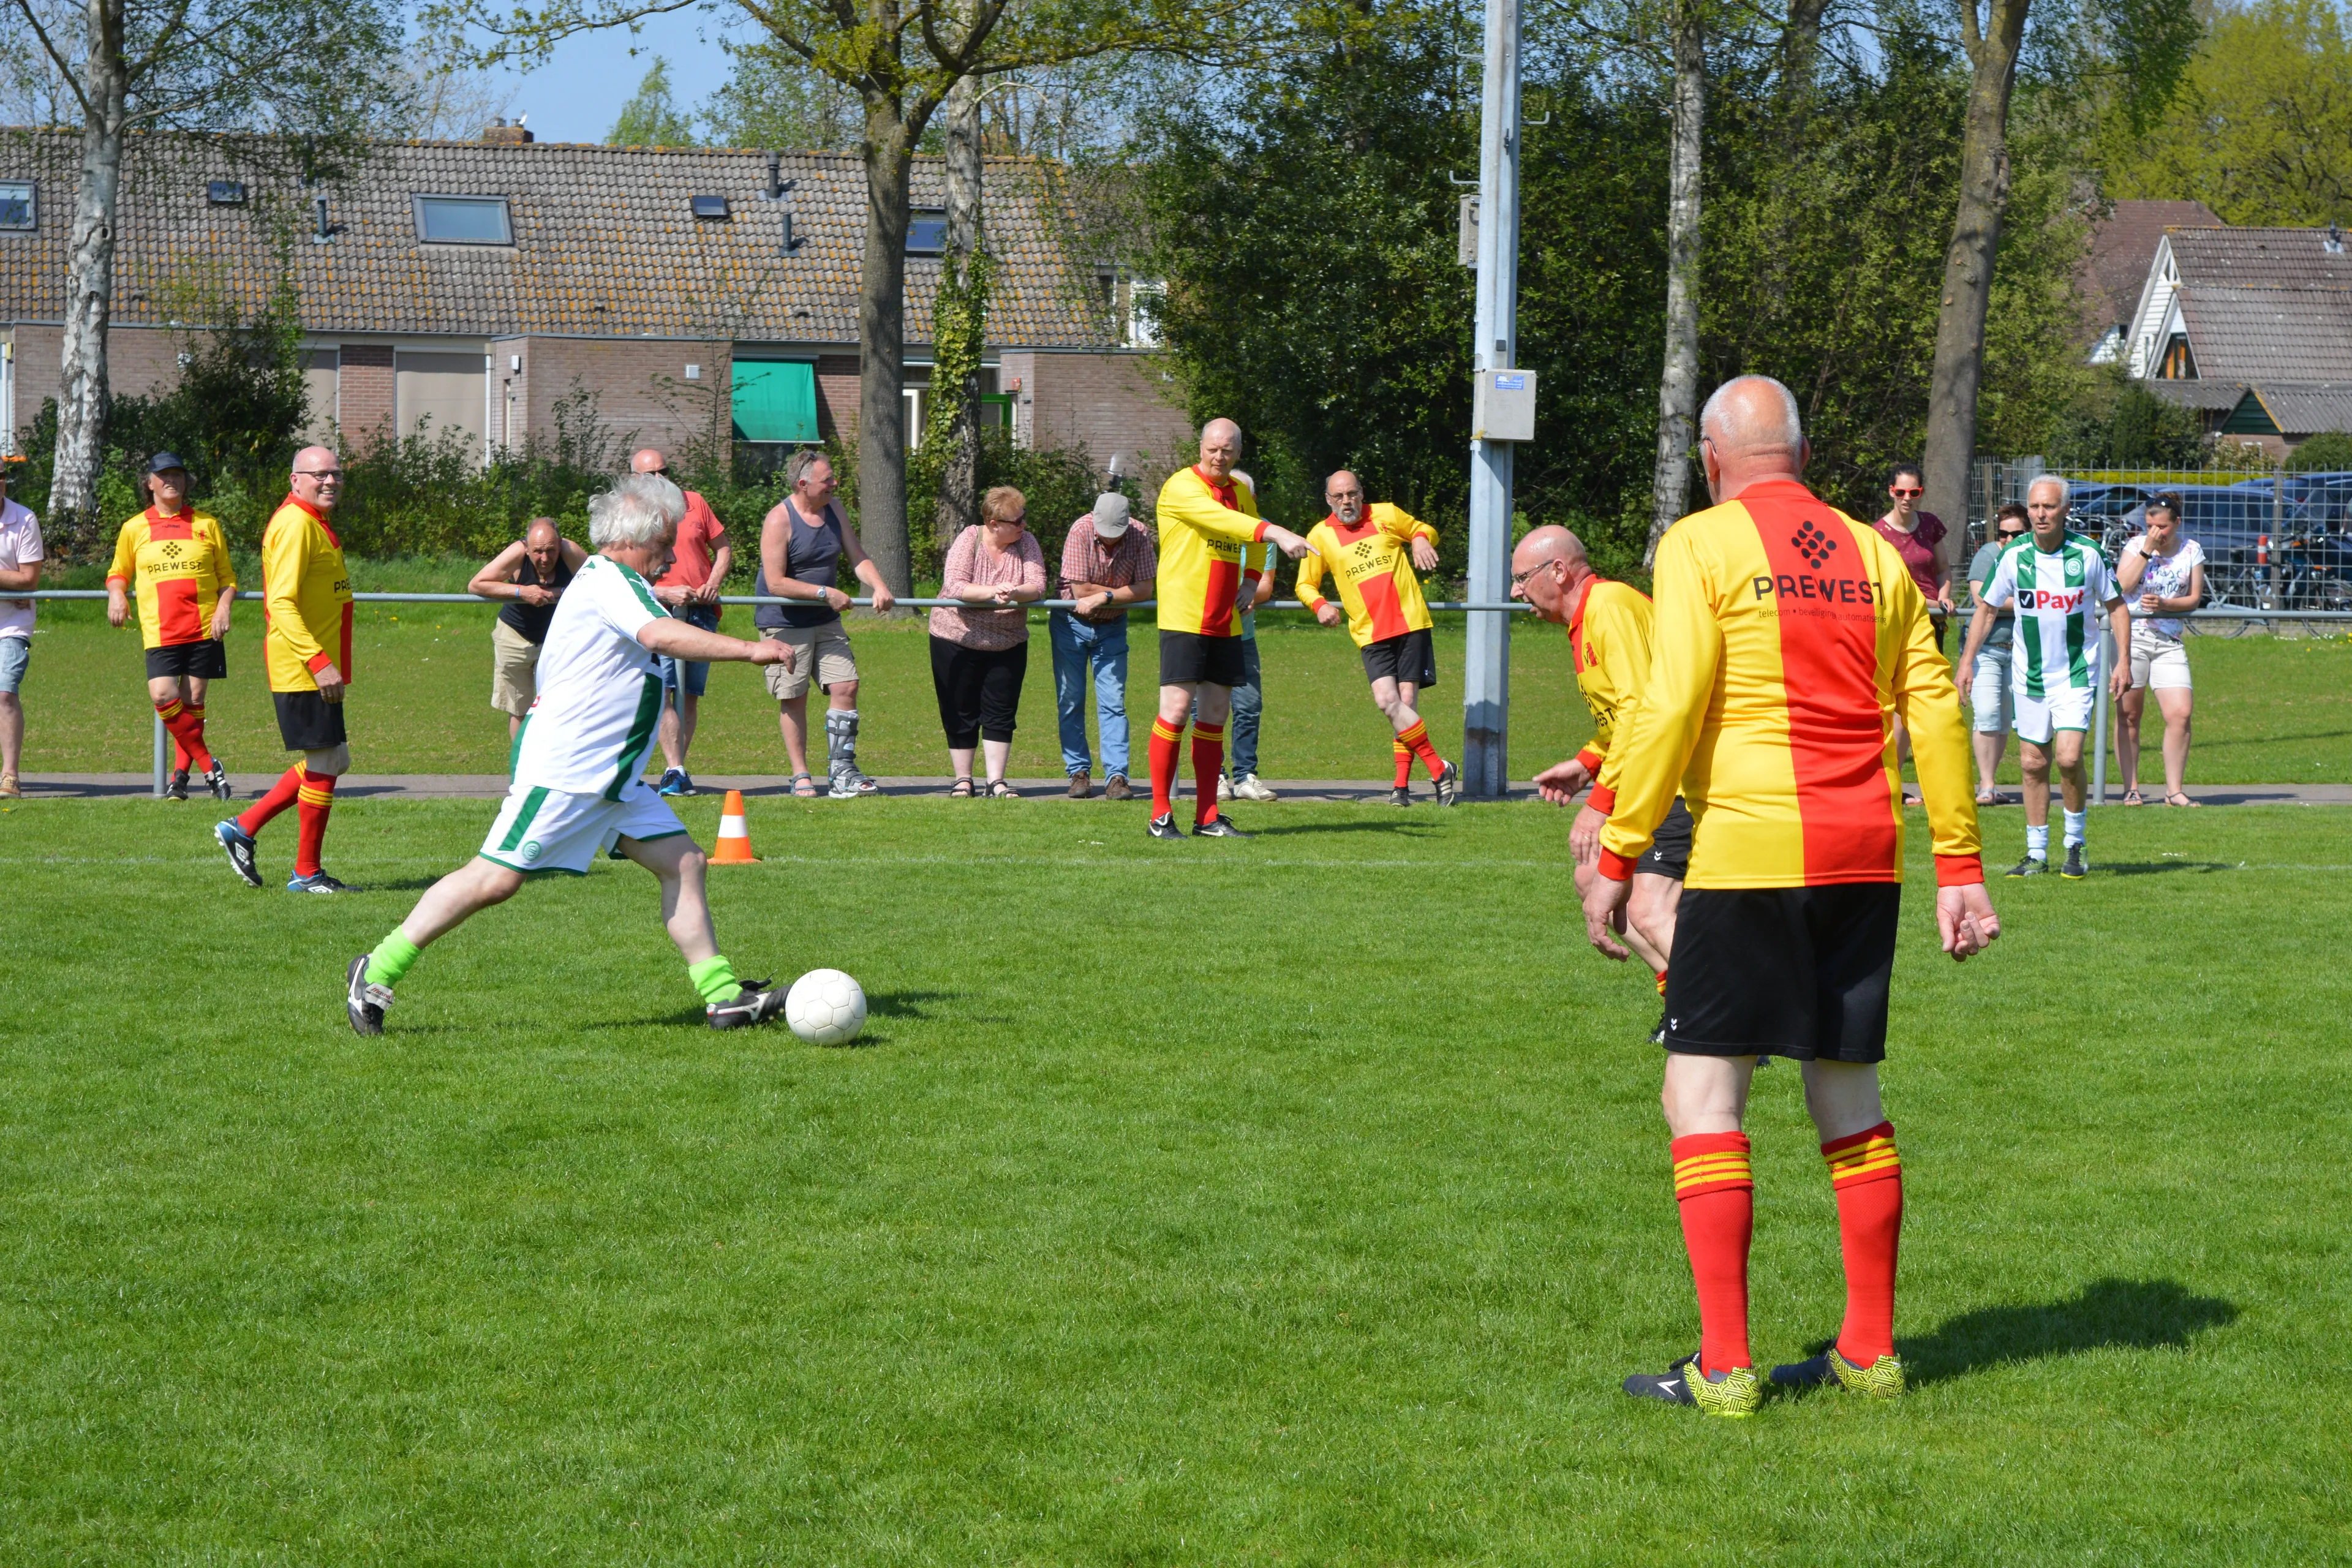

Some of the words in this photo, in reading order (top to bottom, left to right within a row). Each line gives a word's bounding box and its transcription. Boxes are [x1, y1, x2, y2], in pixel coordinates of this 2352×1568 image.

[1207, 538, 1242, 554] PREWES
[148, 560, 202, 575] PREWEST
[1346, 555, 1393, 579] PREWEST
[1753, 575, 1883, 606] PREWEST
[2036, 589, 2084, 613] Payt
[1758, 608, 1790, 618] telecom
[1594, 707, 1616, 728] WEST
